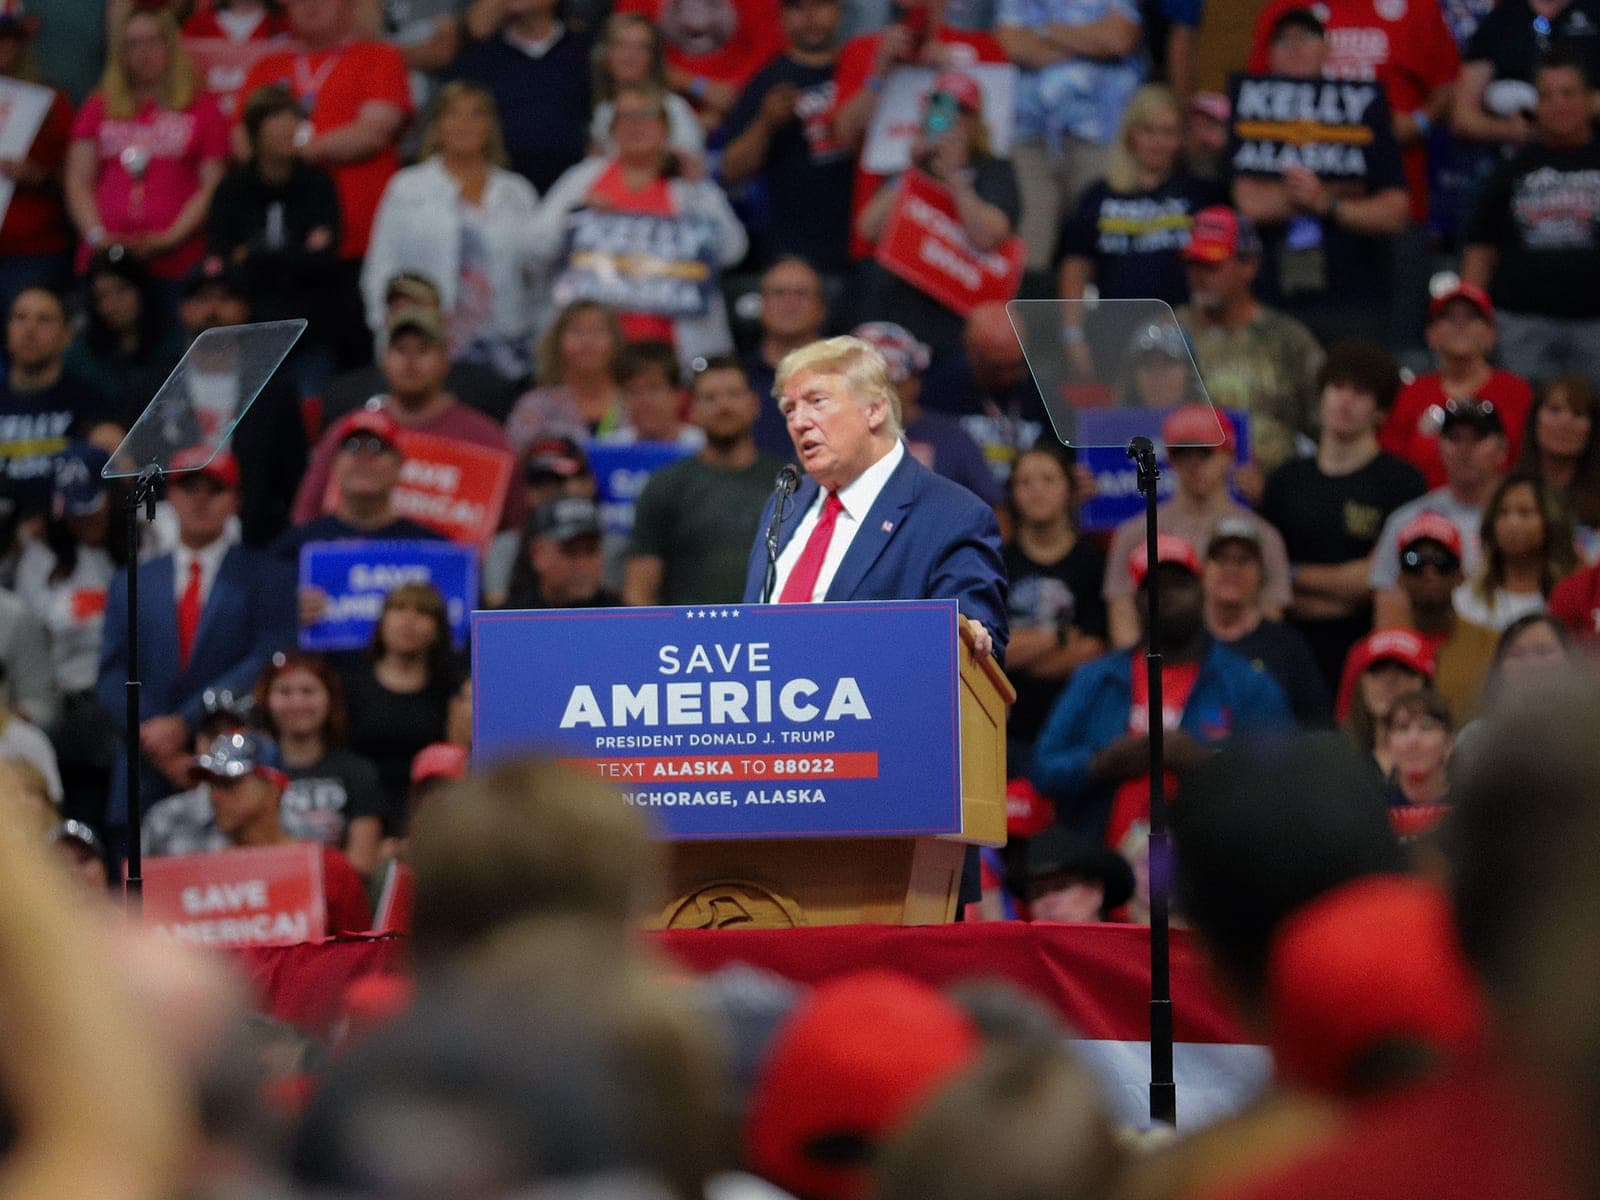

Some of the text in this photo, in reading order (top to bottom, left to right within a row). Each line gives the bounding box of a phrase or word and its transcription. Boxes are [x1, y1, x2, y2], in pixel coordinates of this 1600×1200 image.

[1237, 79, 1376, 124] KELLY
[658, 642, 771, 675] SAVE
[559, 677, 872, 728] AMERICA
[596, 730, 835, 749] PRESIDENT DONALD J. TRUMP
[597, 758, 835, 777] TEXT ALASKA TO 88022
[622, 788, 826, 808] NCHORAGE, ALASKA
[182, 880, 268, 915] SAVE
